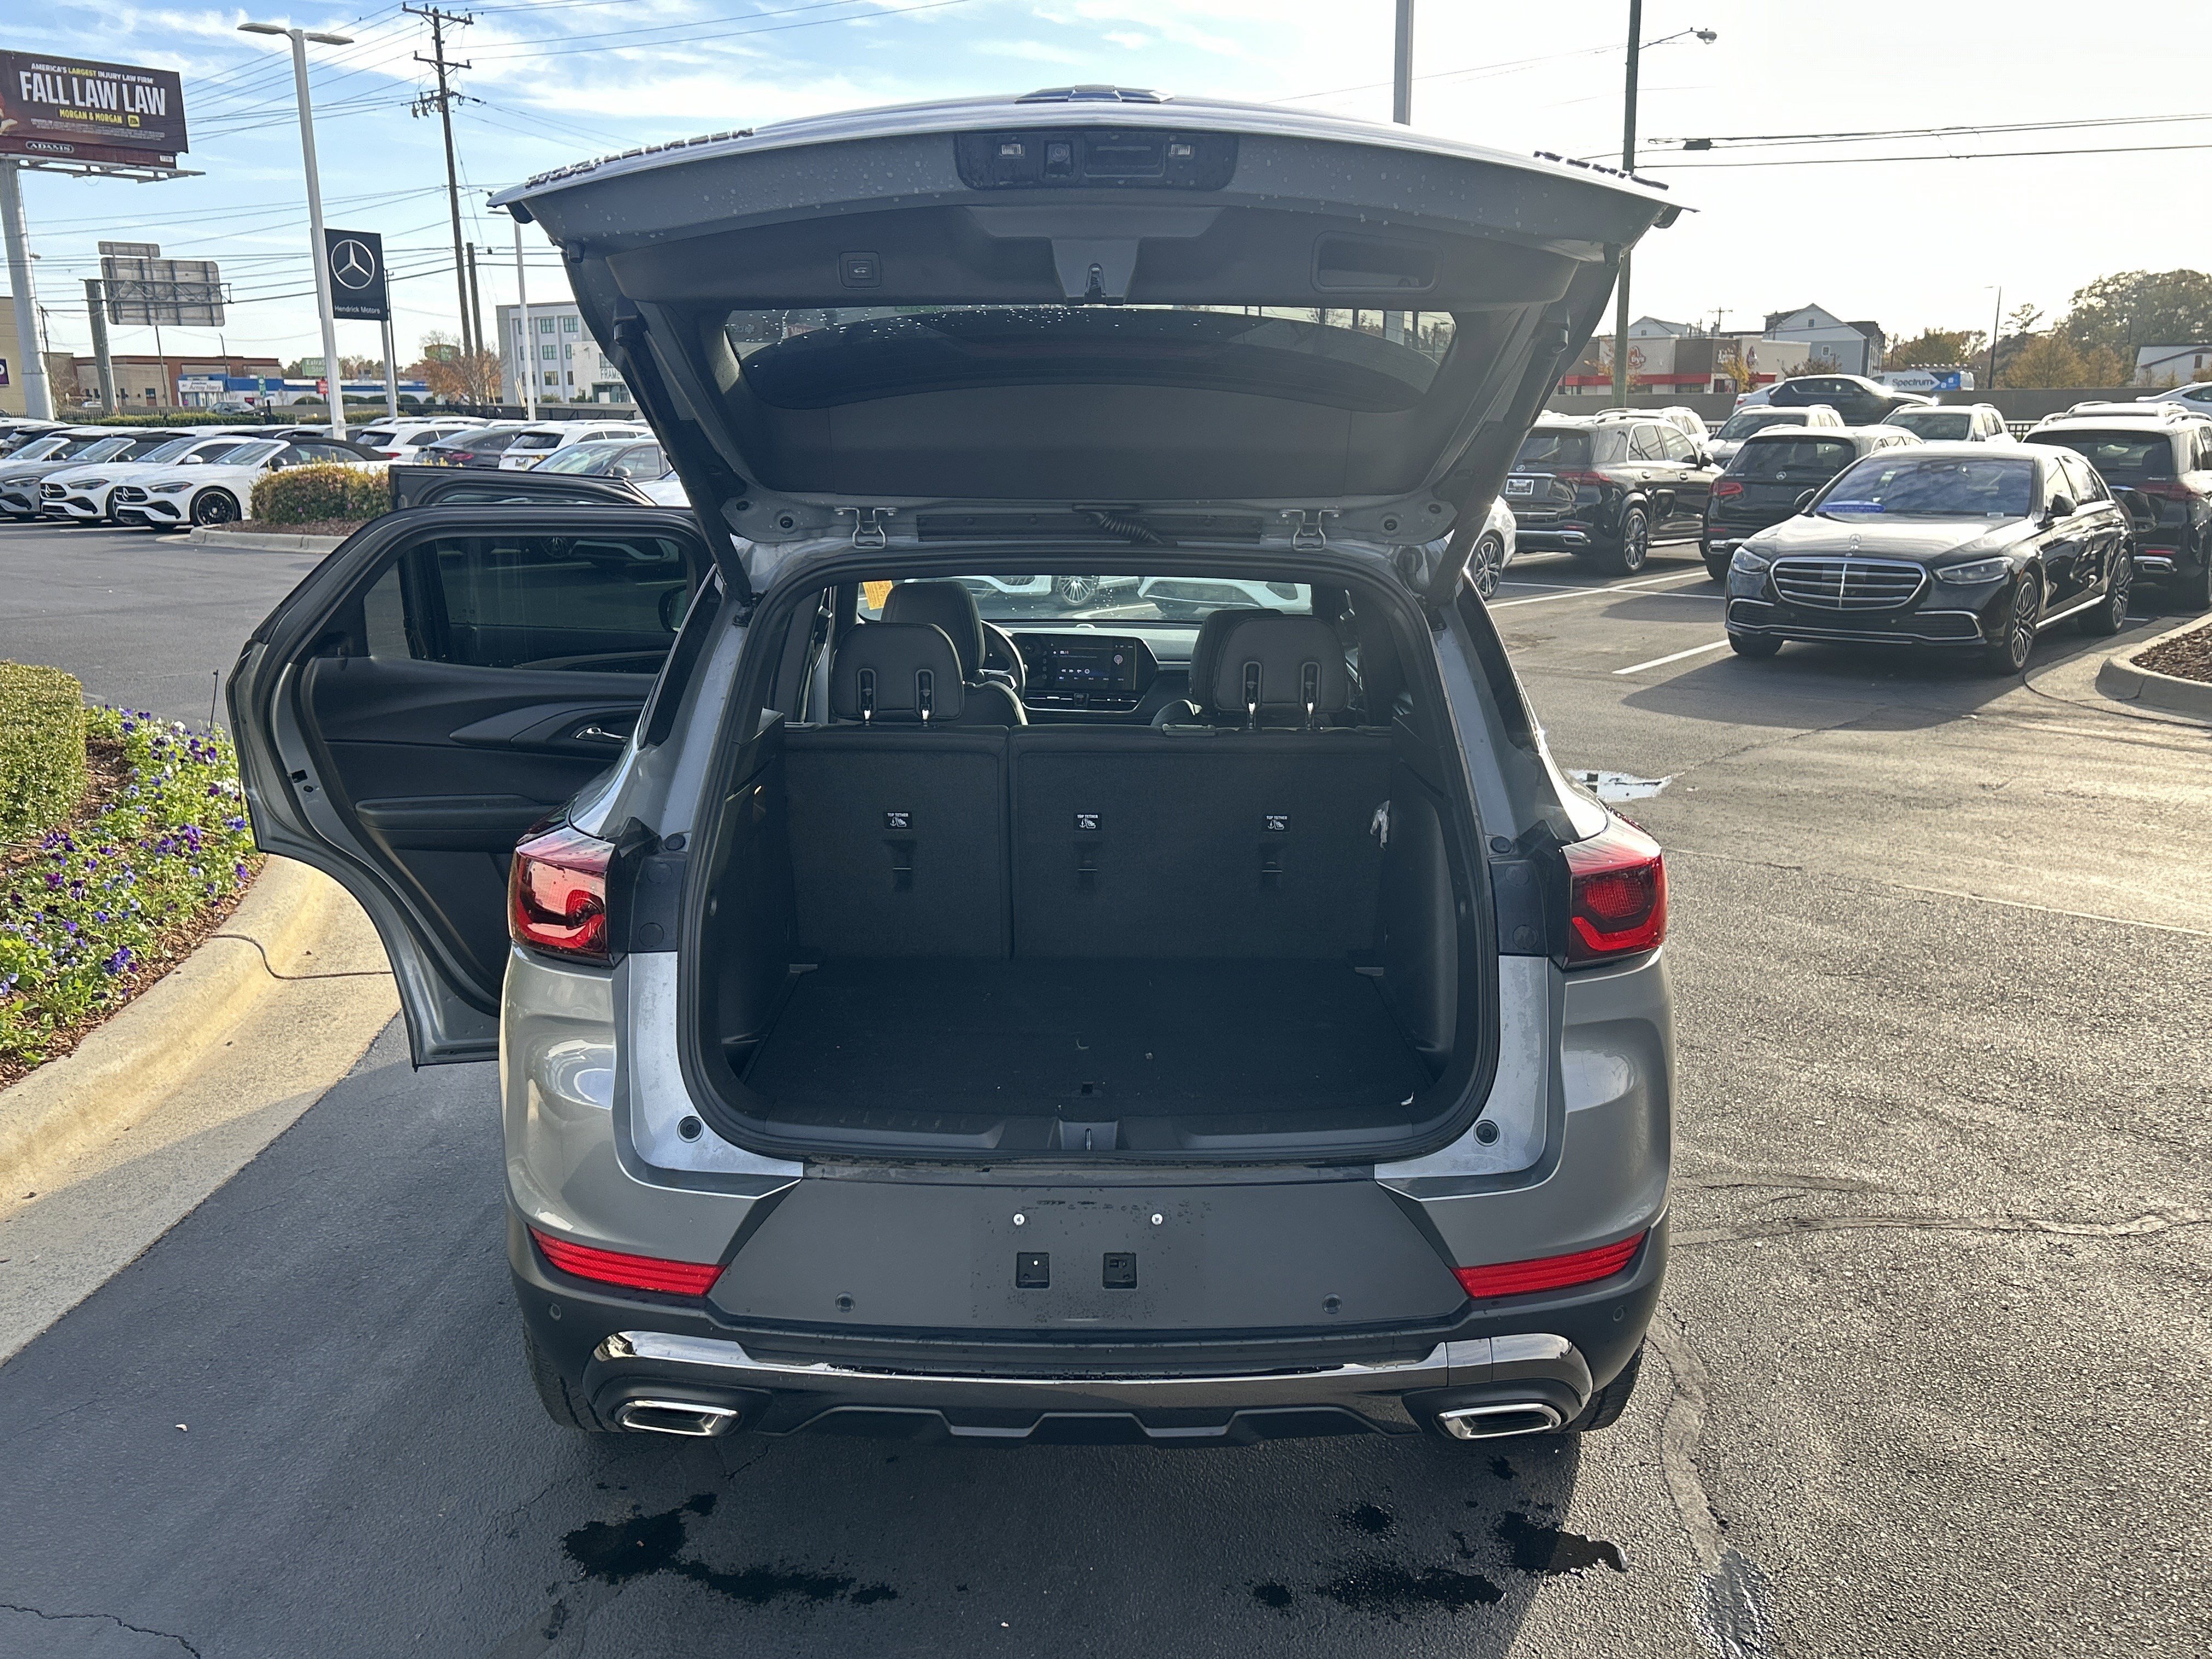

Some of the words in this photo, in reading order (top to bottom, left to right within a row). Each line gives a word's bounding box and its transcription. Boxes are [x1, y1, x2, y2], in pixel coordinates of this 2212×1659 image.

[31, 63, 67, 74] AMERICA'S
[68, 67, 97, 76] LARGEST
[98, 71, 121, 80] INJURY
[122, 74, 136, 82] LAW
[19, 71, 70, 105] FALL
[72, 77, 117, 110] LAW
[122, 83, 165, 116] LAW
[59, 109, 88, 120] MORGAN
[89, 112, 94, 121] &
[95, 112, 122, 124] MORGAN
[360, 306, 380, 314] Motors
[1892, 377, 1933, 387] Spectrum
